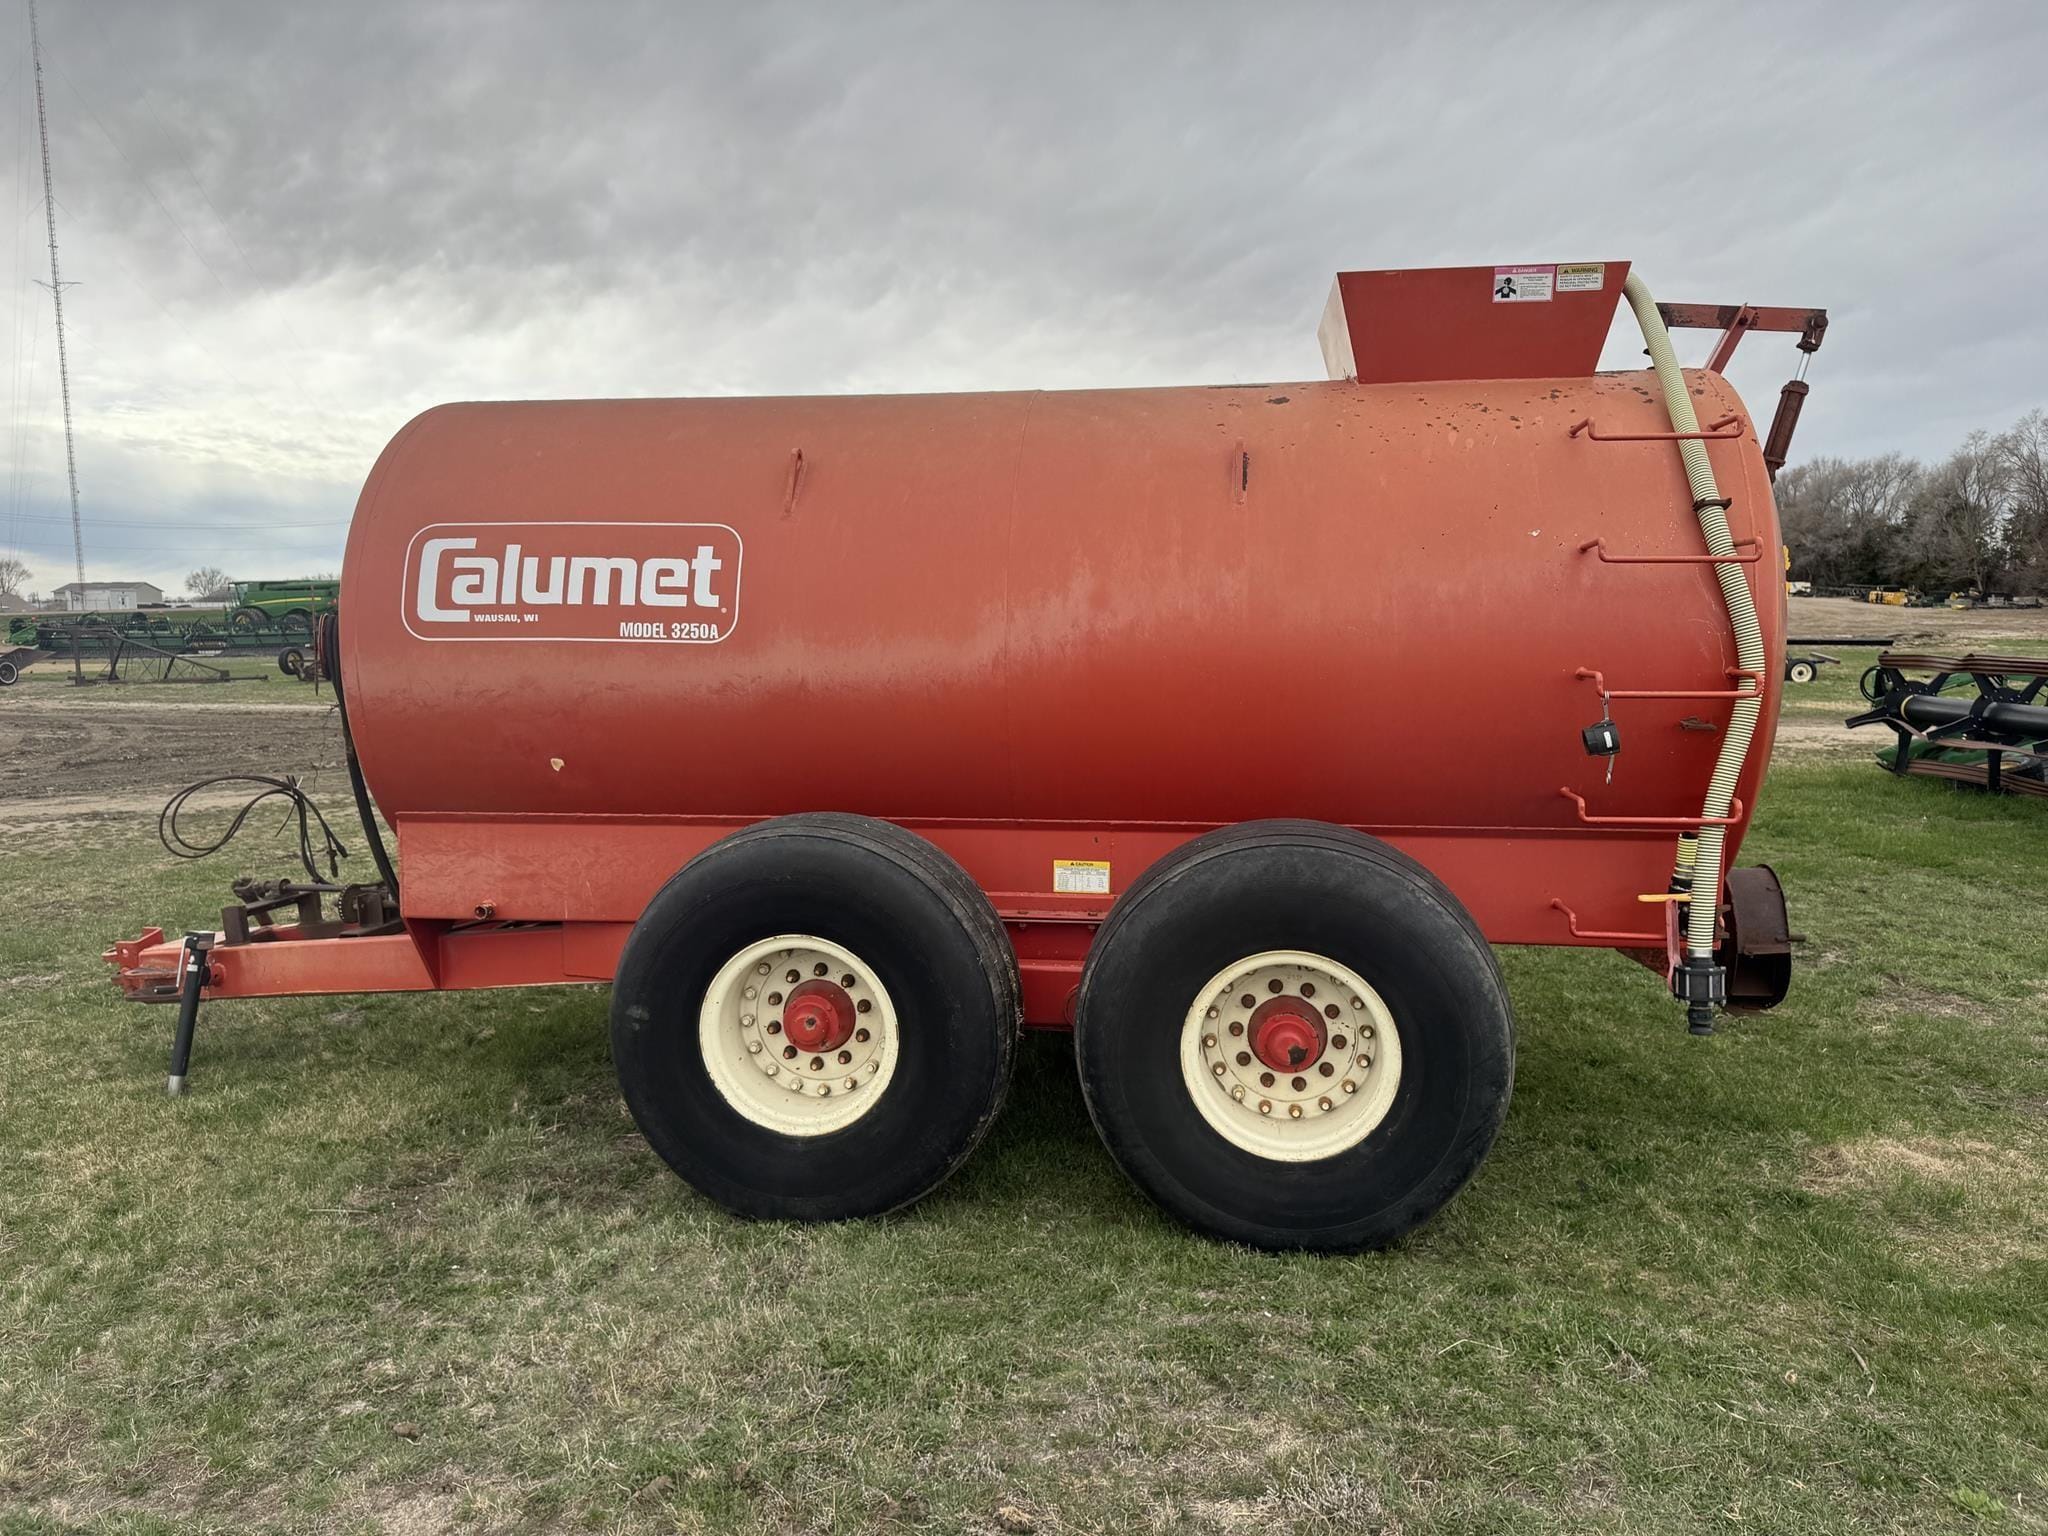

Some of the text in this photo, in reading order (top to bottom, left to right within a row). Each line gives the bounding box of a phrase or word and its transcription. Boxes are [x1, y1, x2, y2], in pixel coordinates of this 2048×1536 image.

[417, 538, 722, 622] Calumet
[474, 614, 539, 624] WAUSAU, WI
[620, 622, 719, 639] MODEL 3250A
